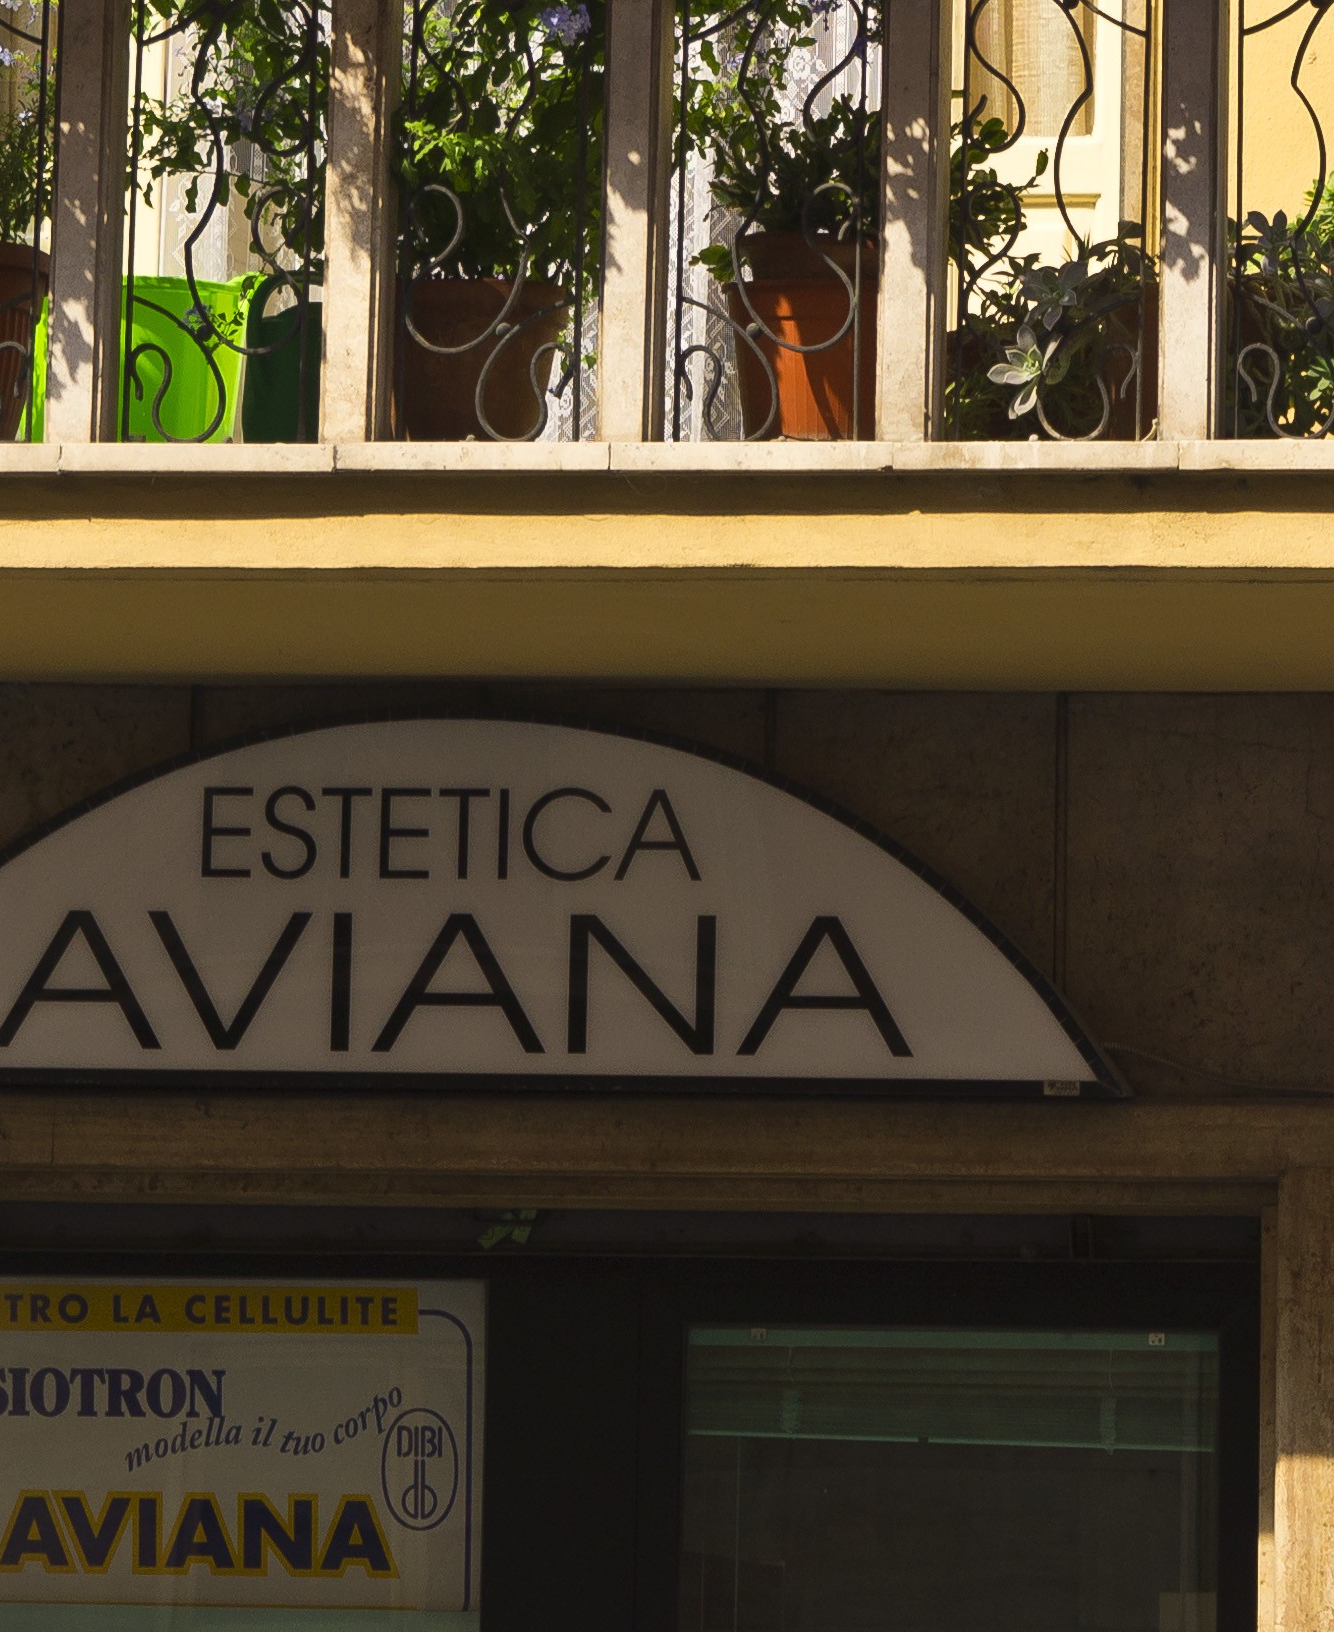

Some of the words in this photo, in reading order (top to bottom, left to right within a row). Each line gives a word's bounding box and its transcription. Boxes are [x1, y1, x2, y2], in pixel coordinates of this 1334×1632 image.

[200, 786, 703, 882] ESTETICA
[112, 1293, 162, 1325] LA
[185, 1294, 400, 1327] CELLULITE
[125, 1417, 243, 1473] modella
[251, 1416, 278, 1449] il
[279, 1430, 326, 1457] tuo
[333, 1386, 404, 1446] corpo
[396, 1425, 443, 1458] DIBI
